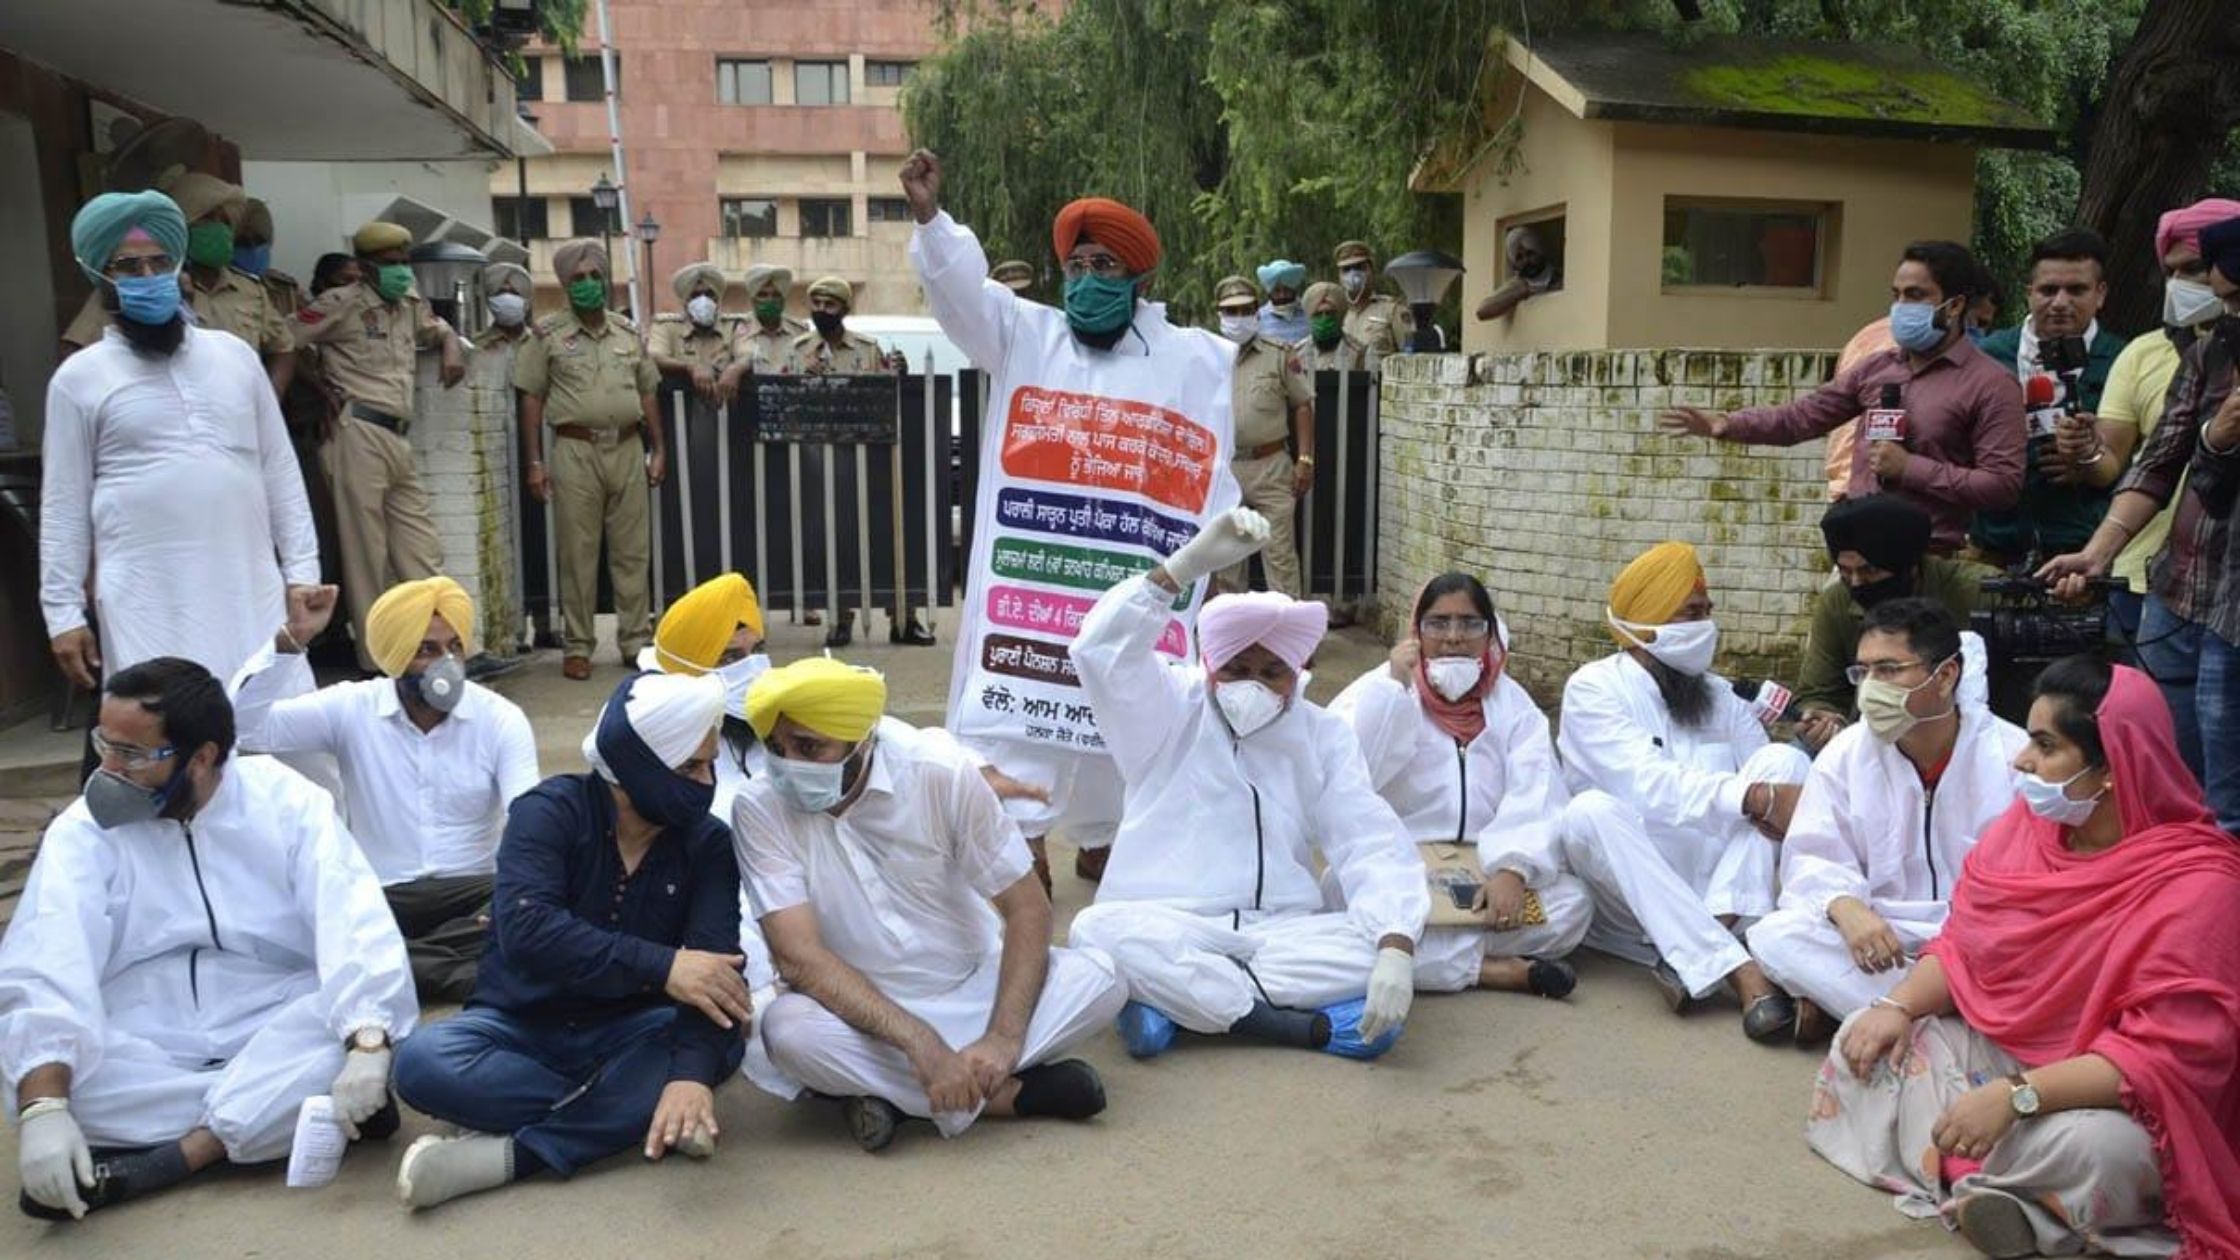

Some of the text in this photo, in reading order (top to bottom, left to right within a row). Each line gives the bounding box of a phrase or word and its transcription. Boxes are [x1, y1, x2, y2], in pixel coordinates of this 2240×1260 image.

[1092, 432, 1116, 450] ਪਾਸ
[1119, 511, 1141, 534] ਹੱਲ
[1054, 606, 1062, 627] 4
[1023, 697, 1061, 720] ਆਮ
